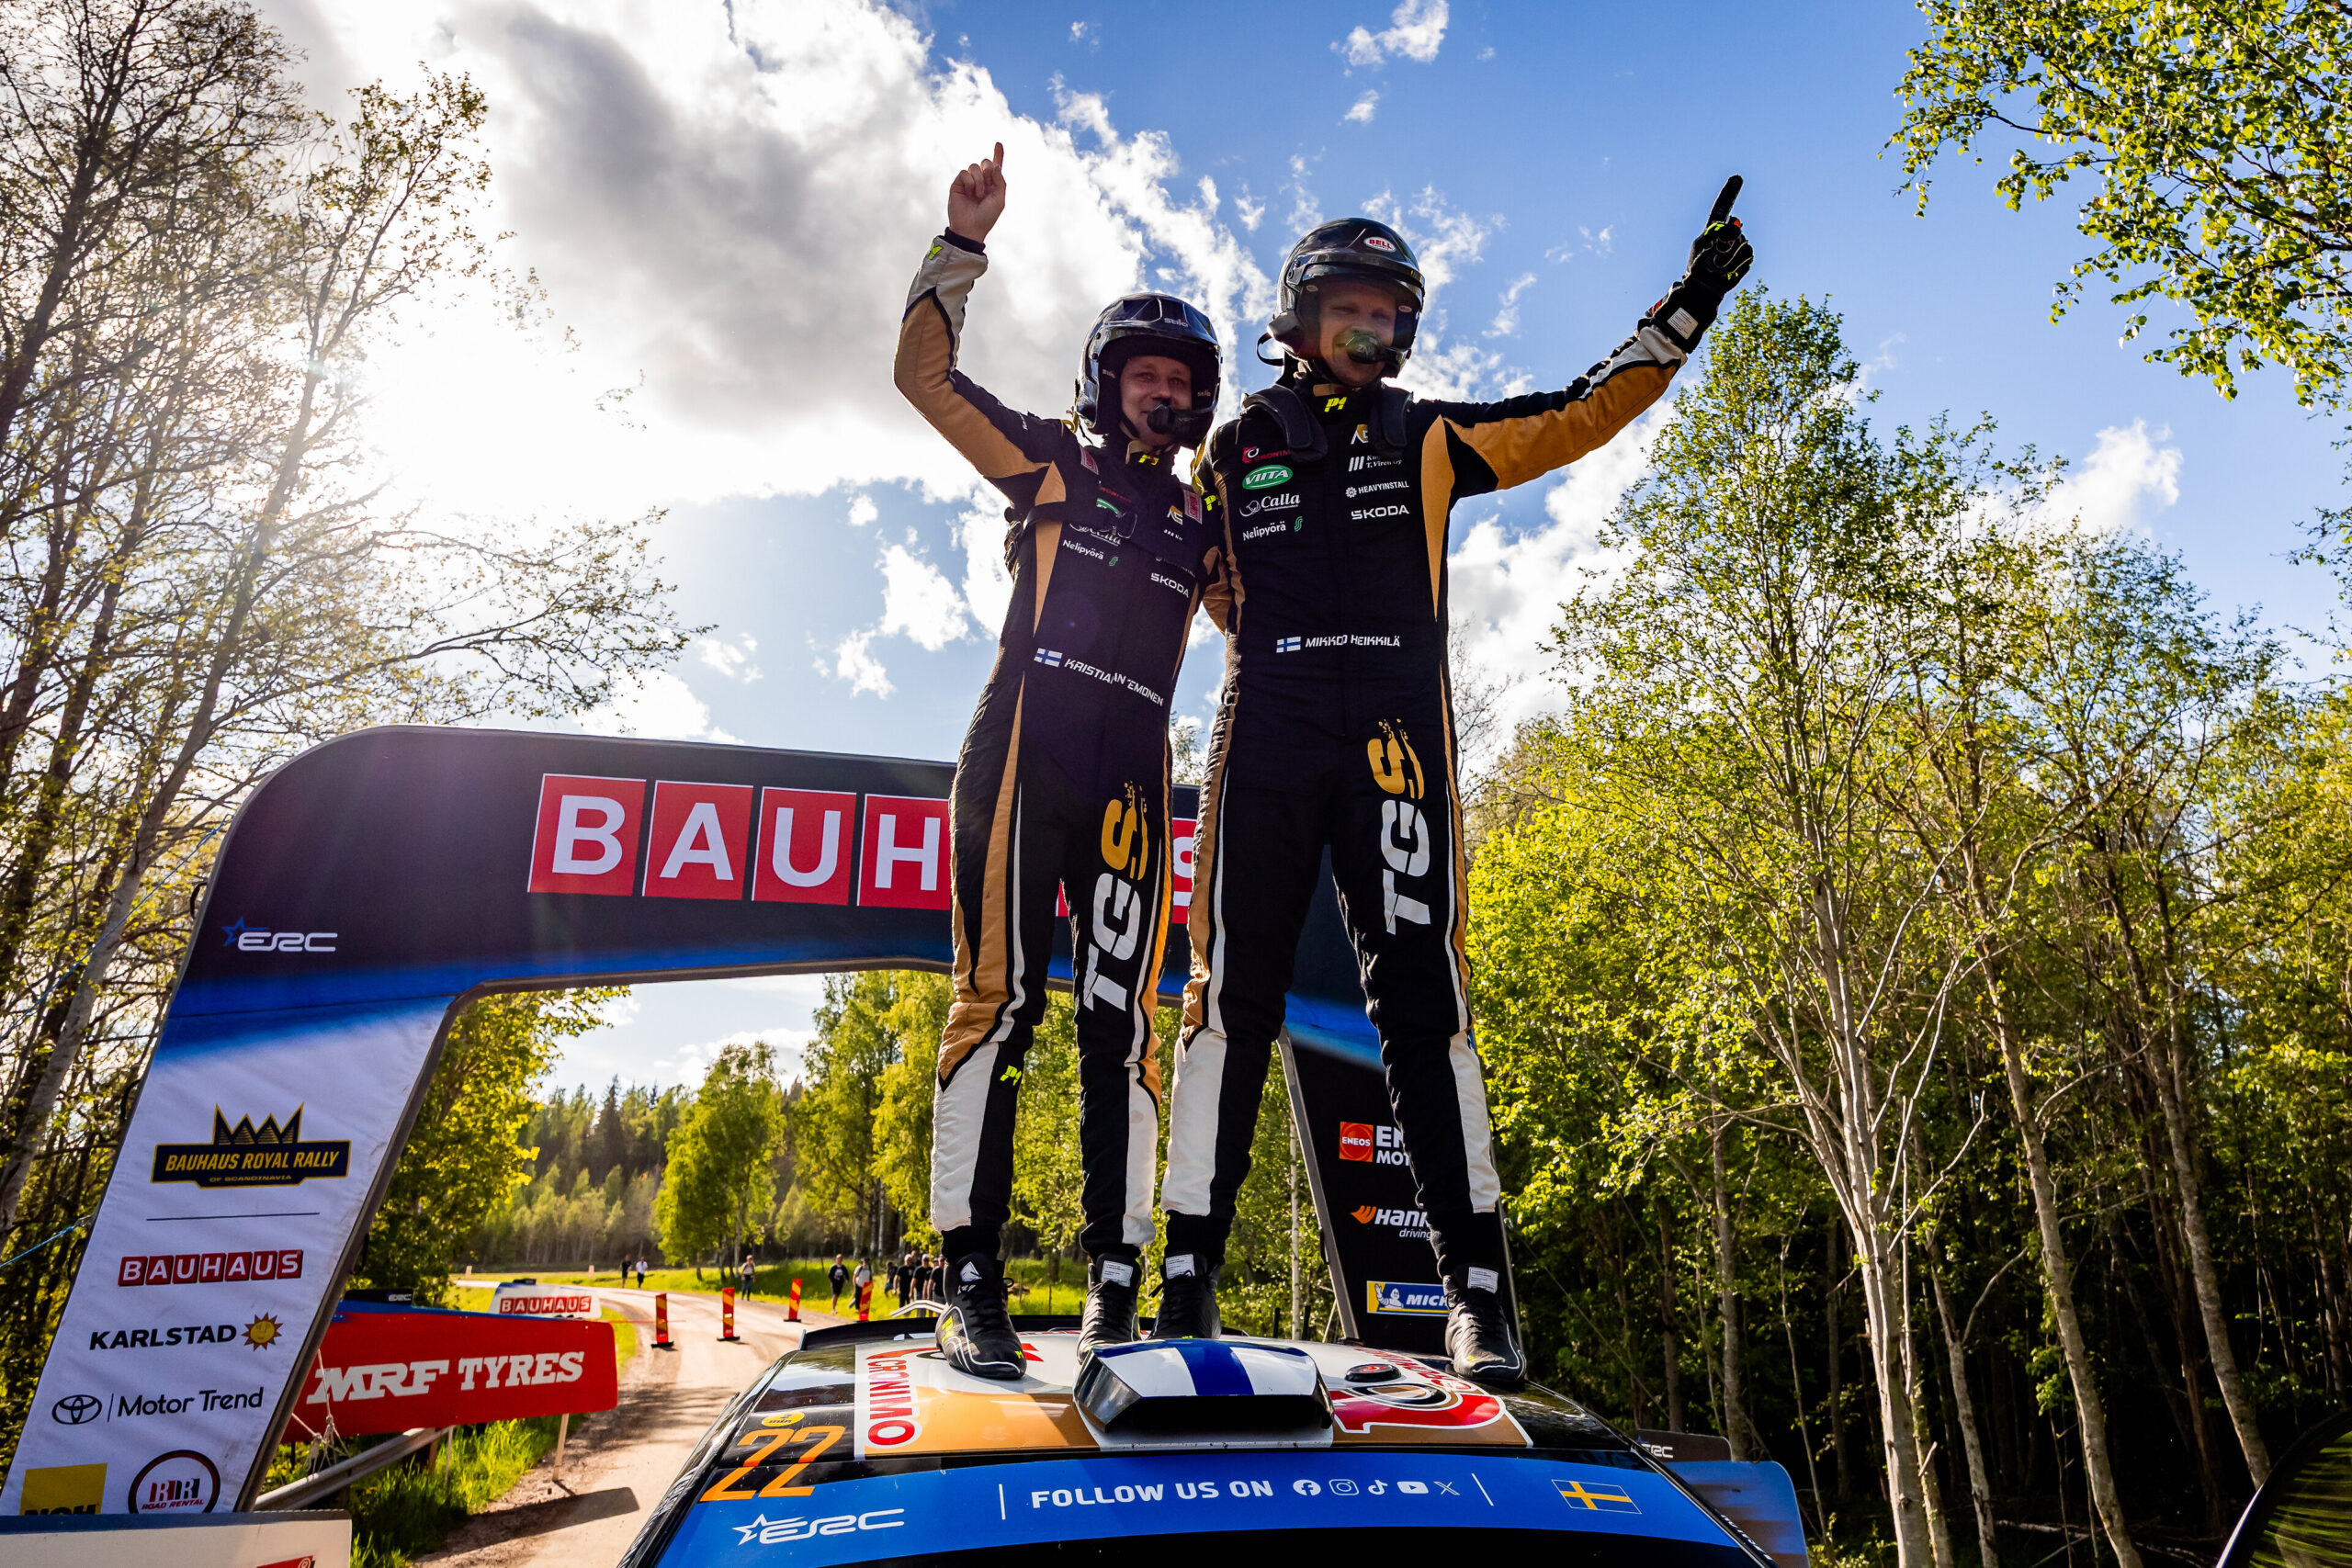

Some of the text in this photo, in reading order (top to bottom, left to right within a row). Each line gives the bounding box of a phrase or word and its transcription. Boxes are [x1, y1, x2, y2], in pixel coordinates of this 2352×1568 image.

[1369, 239, 1392, 249] BELL
[1246, 469, 1288, 485] VIITA
[1358, 481, 1409, 494] HEAVYINSTALL
[1261, 493, 1301, 508] Calla
[1242, 521, 1286, 541] Nelipyörä
[1063, 539, 1104, 559] Nelipyörä
[1306, 635, 1400, 648] MIKKO HEIKKILÄ
[1367, 729, 1431, 935] TGS
[1083, 794, 1148, 1011] TGS
[1341, 1135, 1371, 1147] ENEOS
[164, 1151, 339, 1172] BAUHAUS ROYAL RALLY
[224, 1174, 292, 1183] SCANDINAVIA
[121, 1252, 300, 1283] BAUHAUS
[501, 1297, 590, 1313] BAUHAUS
[89, 1325, 237, 1350] KARLSTAD
[306, 1351, 584, 1404] MRF TYRES
[118, 1387, 264, 1417] Motor Trend
[699, 1426, 845, 1502] 22
[141, 1499, 204, 1510] ROAD RENTAL
[1031, 1480, 1273, 1509] FOLLOW US ON
